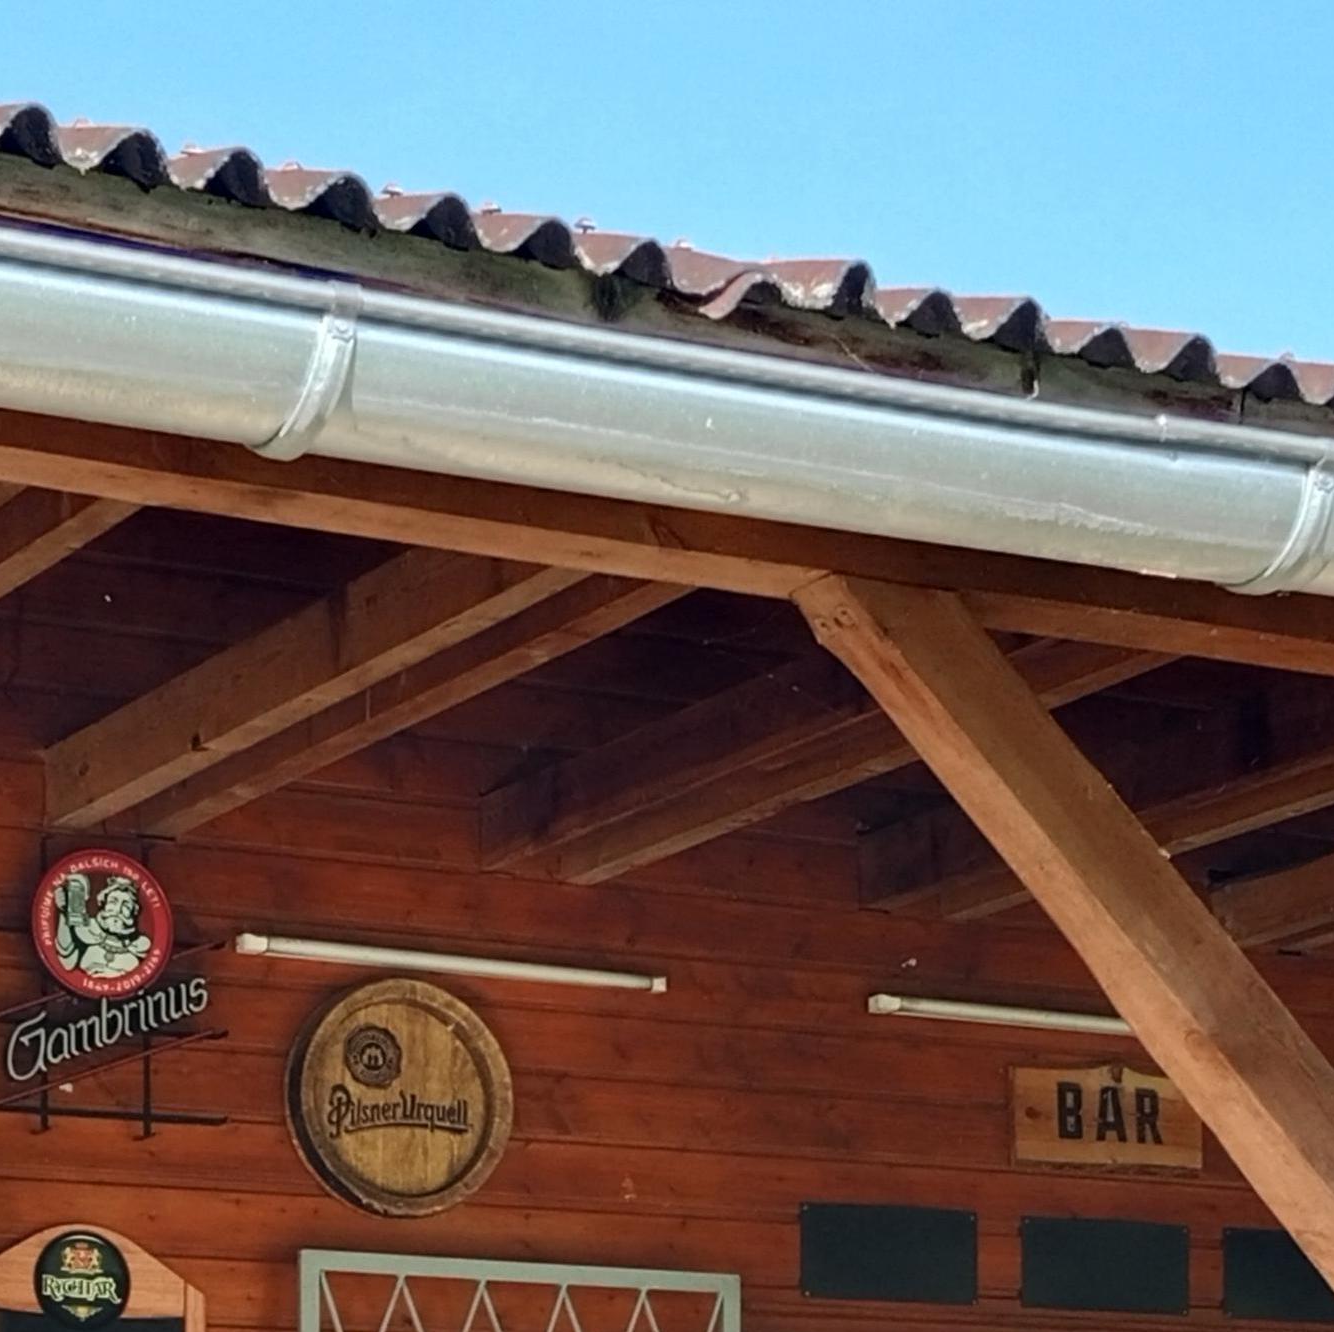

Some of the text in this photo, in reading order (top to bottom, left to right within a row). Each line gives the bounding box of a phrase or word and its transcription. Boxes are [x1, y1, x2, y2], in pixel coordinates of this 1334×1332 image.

[7, 977, 207, 1080] Gambrinus
[328, 1083, 469, 1139] Pilsner Urquell
[1056, 1081, 1164, 1145] BAR
